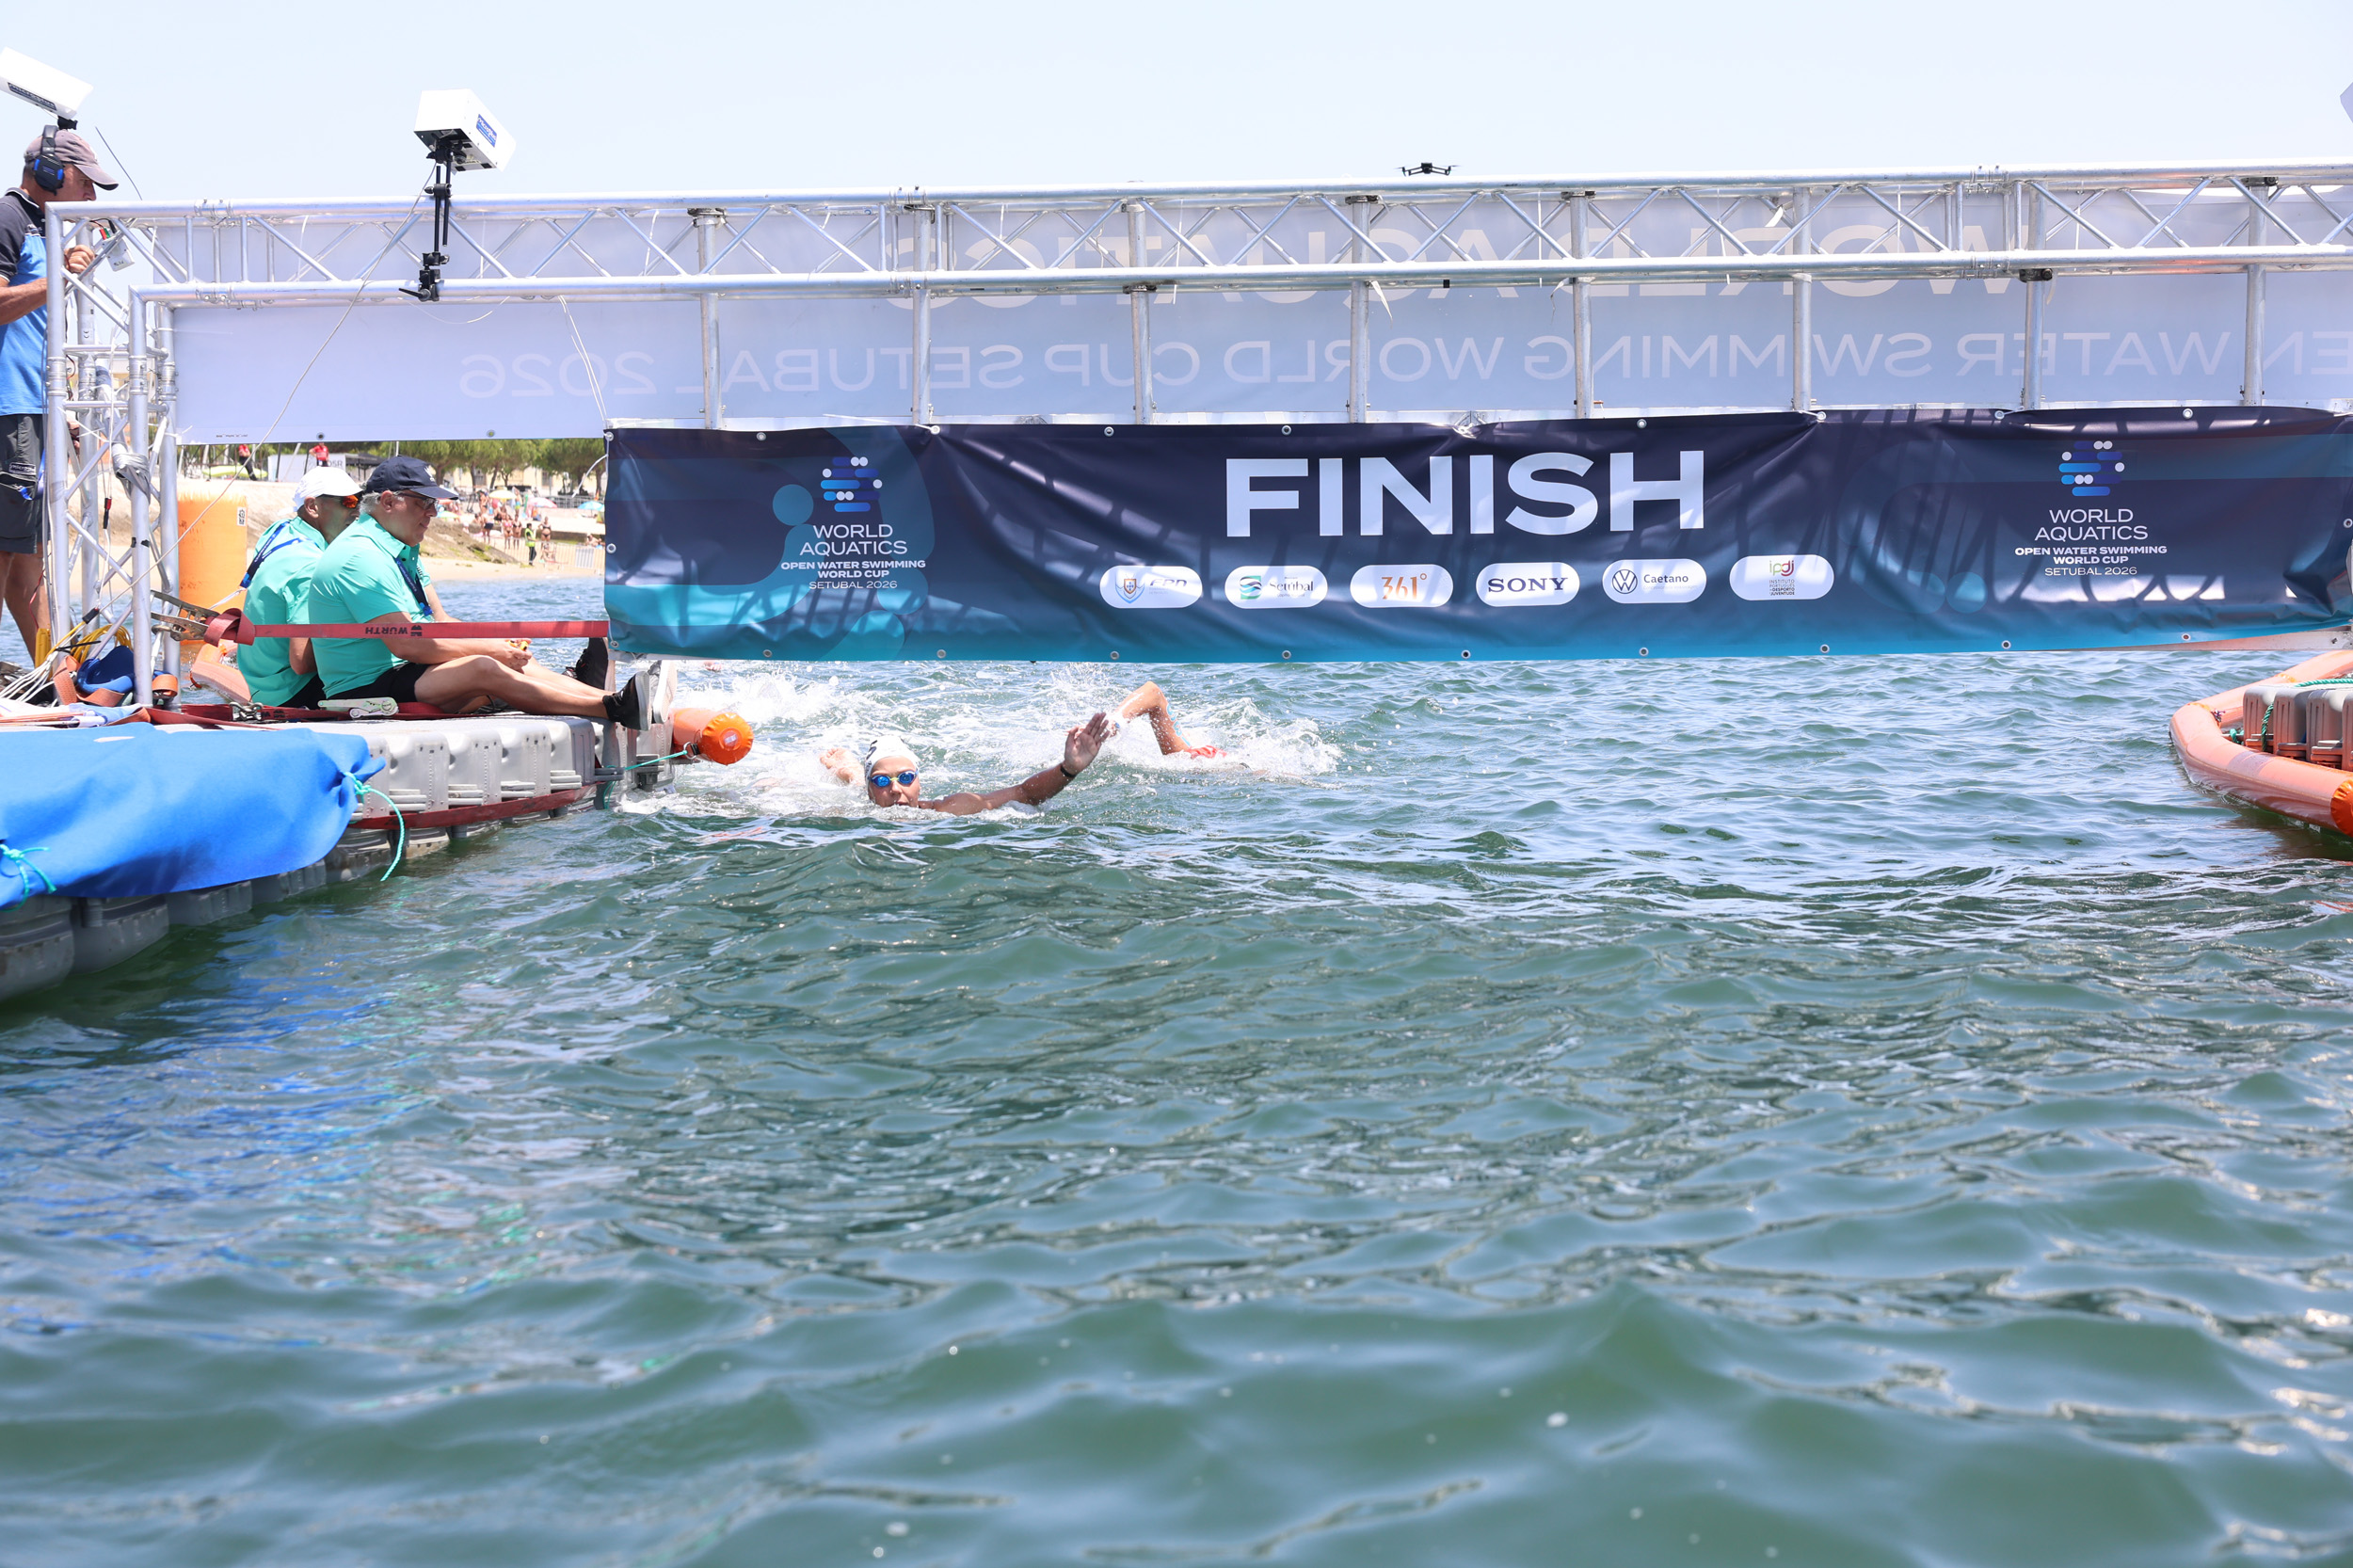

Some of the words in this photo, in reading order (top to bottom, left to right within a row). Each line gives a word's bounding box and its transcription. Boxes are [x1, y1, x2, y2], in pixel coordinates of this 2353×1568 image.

[1226, 450, 1705, 537] FINISH
[2049, 508, 2134, 523] WORLD
[812, 524, 893, 538] WORLD
[2034, 525, 2149, 542] AQUATICS
[799, 540, 908, 556] AQUATICS
[2014, 547, 2051, 555] OPEN
[2053, 546, 2097, 555] WATER
[2099, 545, 2168, 554] SWIMMING
[817, 561, 860, 569] WATER
[861, 560, 926, 568] SWIMMING
[2053, 556, 2100, 565] WORLD
[2102, 555, 2129, 564] CUP
[864, 569, 889, 578] CUP
[2044, 568, 2102, 576] SETUBAL
[2105, 567, 2137, 575] 2026
[1643, 574, 1689, 584] Caetano
[808, 581, 863, 589] SETUBAL
[866, 580, 898, 589] 2026
[1487, 577, 1568, 593] SONY
[364, 626, 408, 635] WÜRTH
